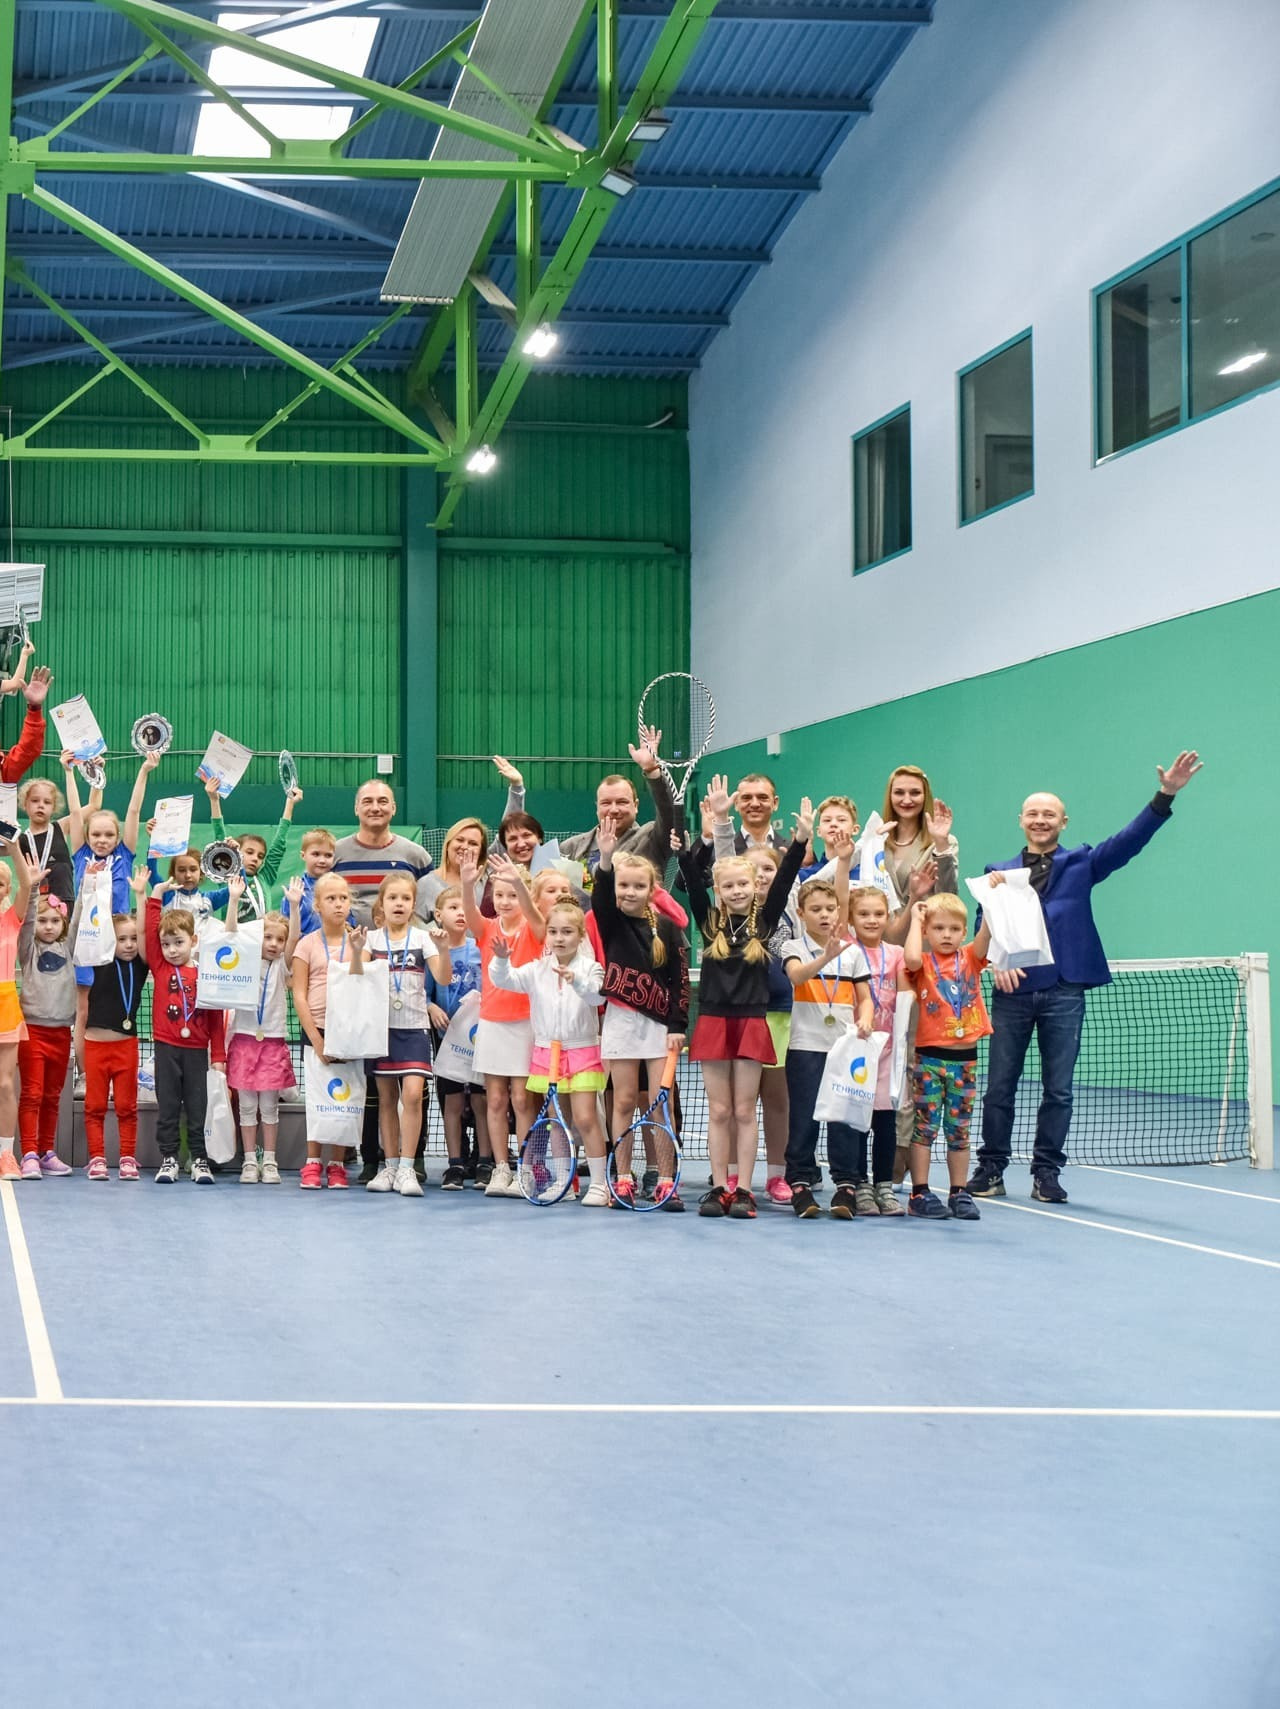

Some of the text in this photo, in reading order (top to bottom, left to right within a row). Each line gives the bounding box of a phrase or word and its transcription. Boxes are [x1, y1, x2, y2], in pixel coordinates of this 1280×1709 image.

[201, 972, 253, 984] ТЕННИС ХОЛЛ
[315, 1104, 346, 1113] ТЕННИС
